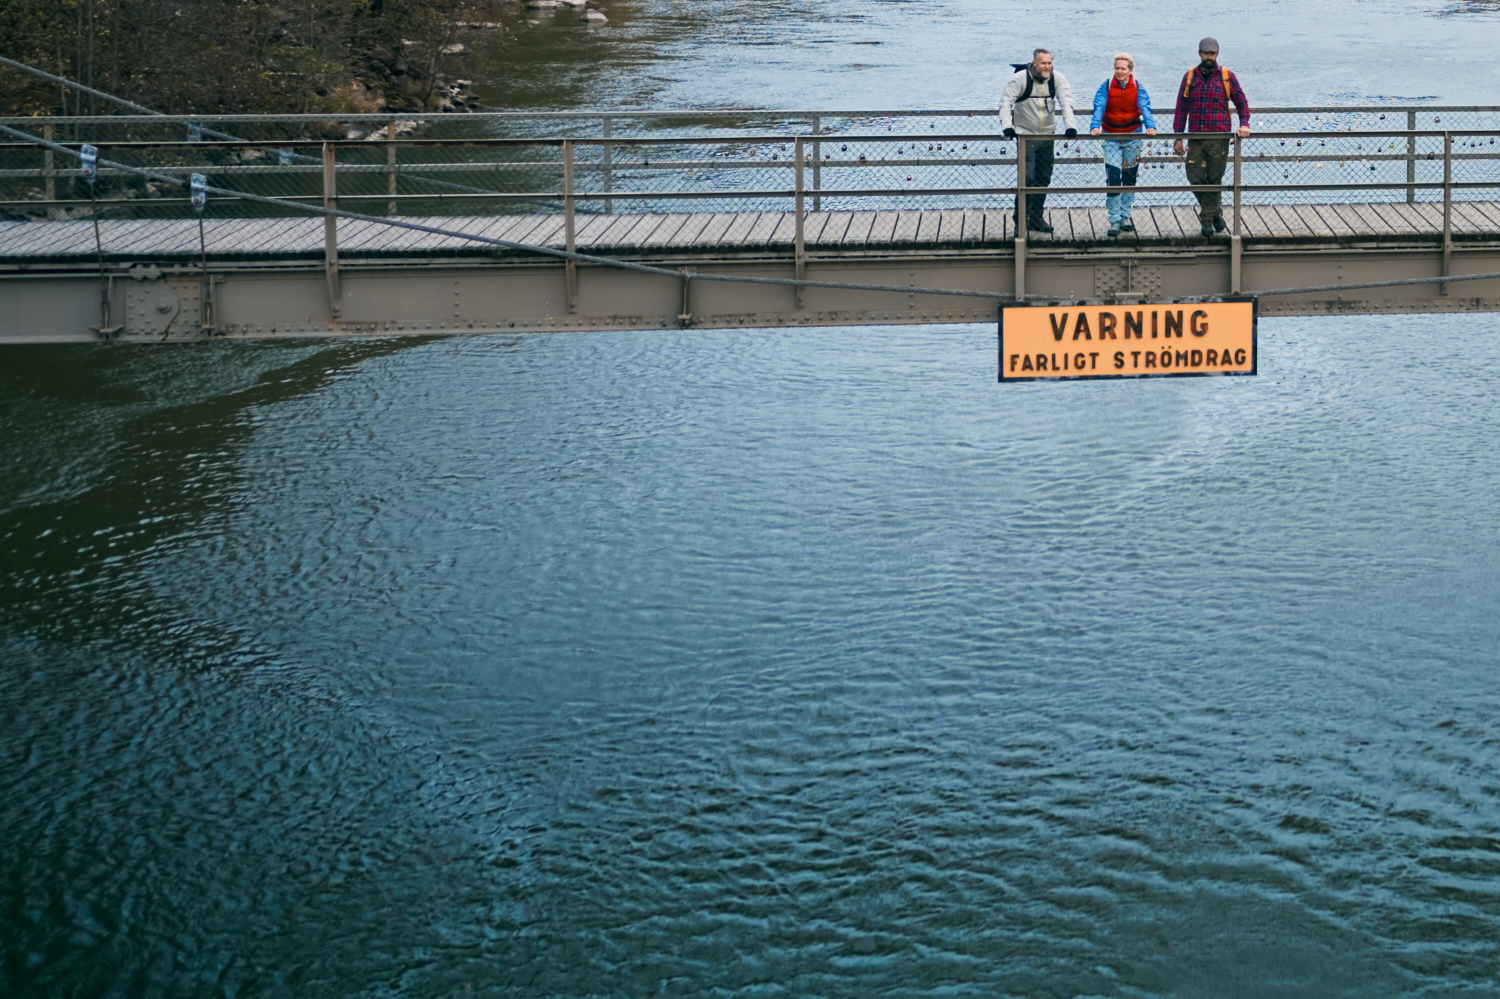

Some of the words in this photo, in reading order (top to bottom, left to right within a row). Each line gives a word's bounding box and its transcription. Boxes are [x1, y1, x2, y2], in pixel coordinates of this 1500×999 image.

[1049, 310, 1209, 341] VARNING
[1010, 352, 1100, 372] FARLIGT
[1114, 346, 1247, 369] STRÖMDRAG
